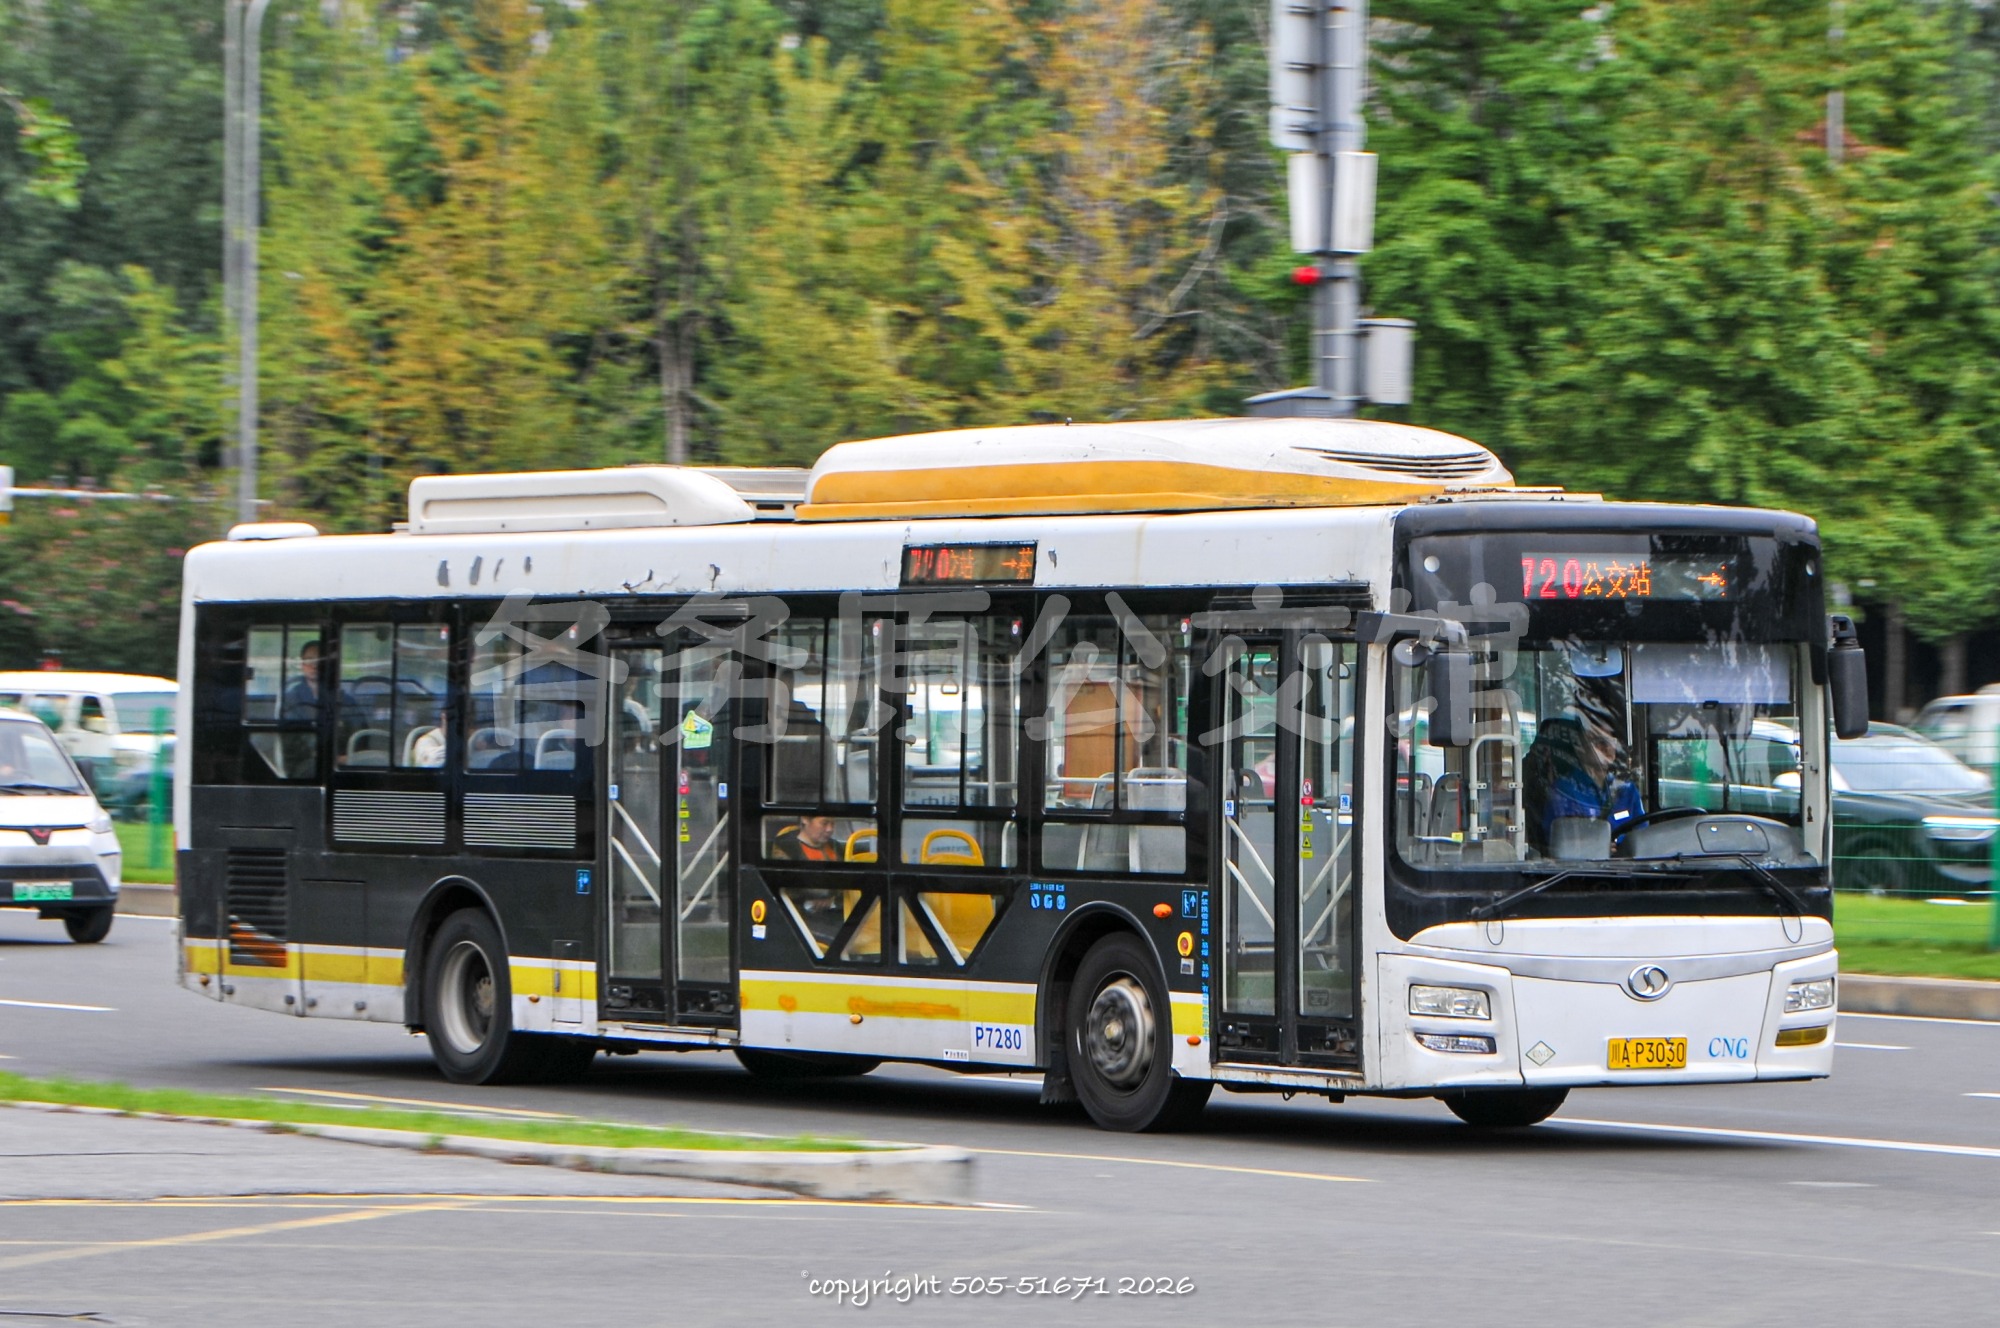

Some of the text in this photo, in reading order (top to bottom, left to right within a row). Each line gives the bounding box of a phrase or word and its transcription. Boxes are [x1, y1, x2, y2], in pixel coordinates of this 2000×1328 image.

[1522, 558, 1651, 598] 720 公交站
[975, 1026, 1022, 1050] P7280
[1708, 1036, 1749, 1059] CNG
